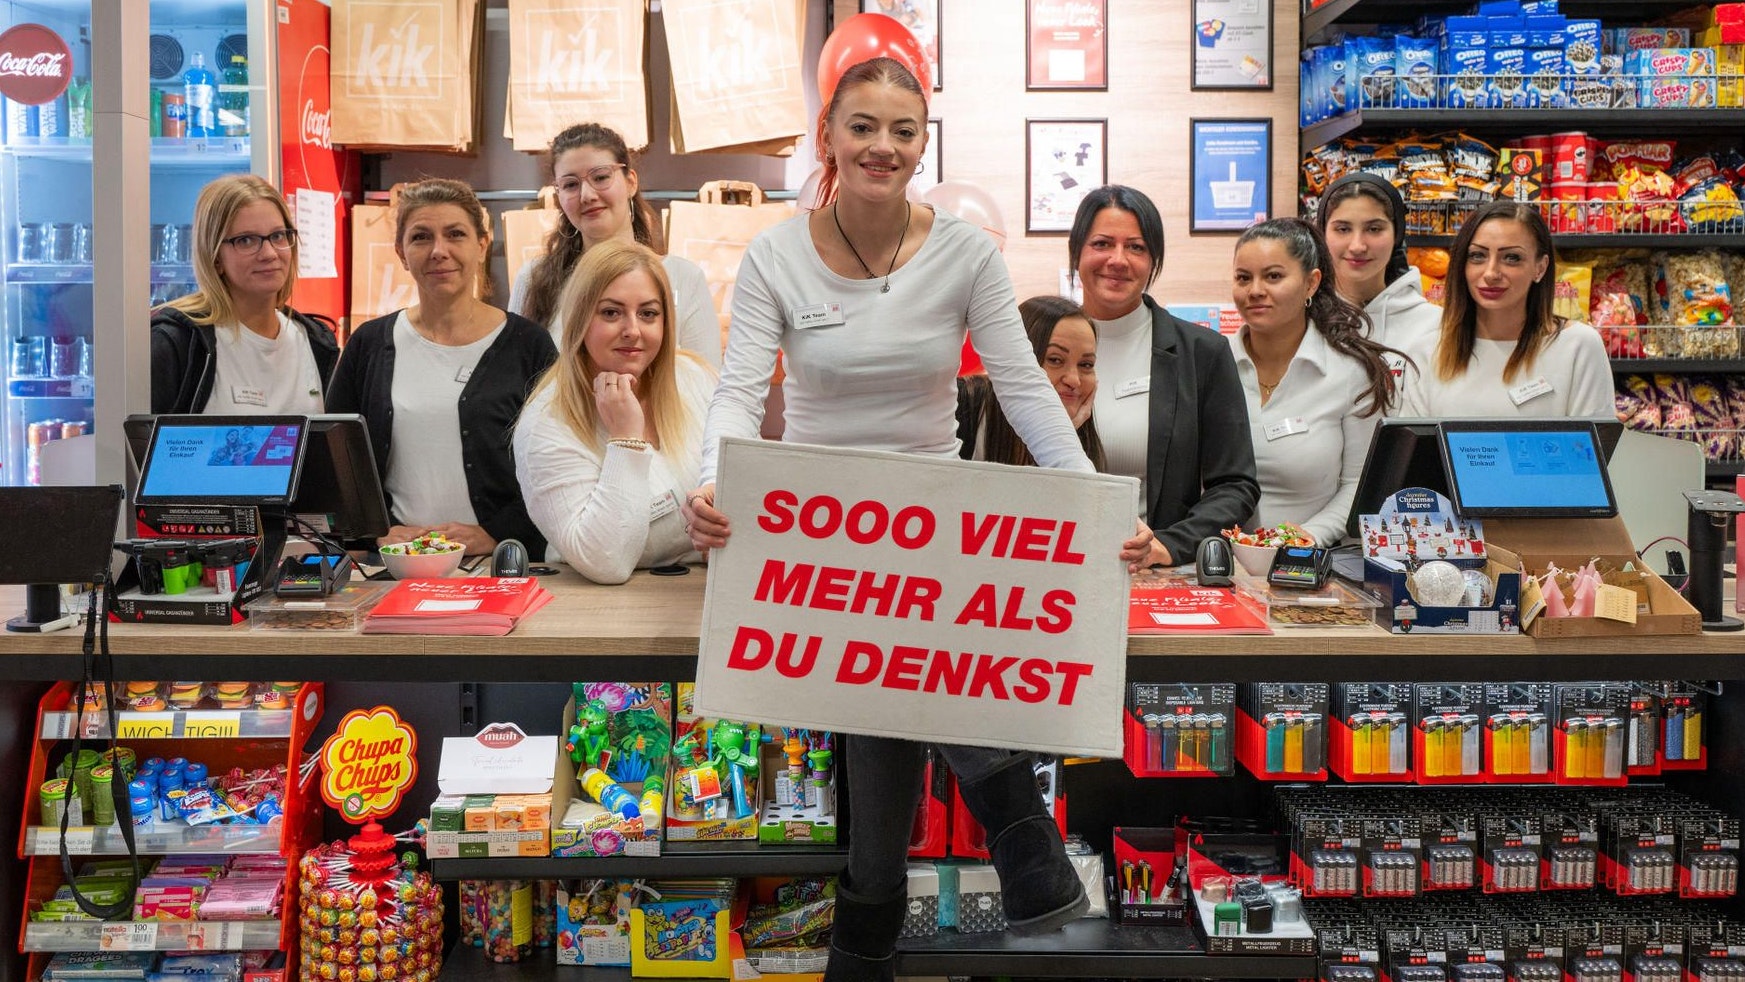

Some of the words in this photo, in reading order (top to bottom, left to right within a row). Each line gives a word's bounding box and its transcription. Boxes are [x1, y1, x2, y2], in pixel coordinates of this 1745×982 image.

[1566, 23, 1597, 34] OREO
[356, 22, 433, 88] kik
[537, 26, 613, 93] kik
[1456, 50, 1486, 60] OREO
[1493, 49, 1524, 60] OREO
[1532, 50, 1562, 60] OREO
[1652, 56, 1687, 67] CRISPY
[1659, 65, 1683, 73] CUPS
[1654, 85, 1689, 96] CRISPY
[1660, 93, 1684, 102] CUPS
[757, 490, 936, 549] SOOO
[961, 511, 1085, 565] VIEL
[754, 559, 942, 622] MEHR
[955, 583, 1077, 634] ALS
[727, 626, 823, 679] DU
[835, 640, 1093, 706] DENKST
[485, 731, 517, 741] muah
[339, 738, 404, 765] Chupa
[336, 761, 401, 801] Chups
